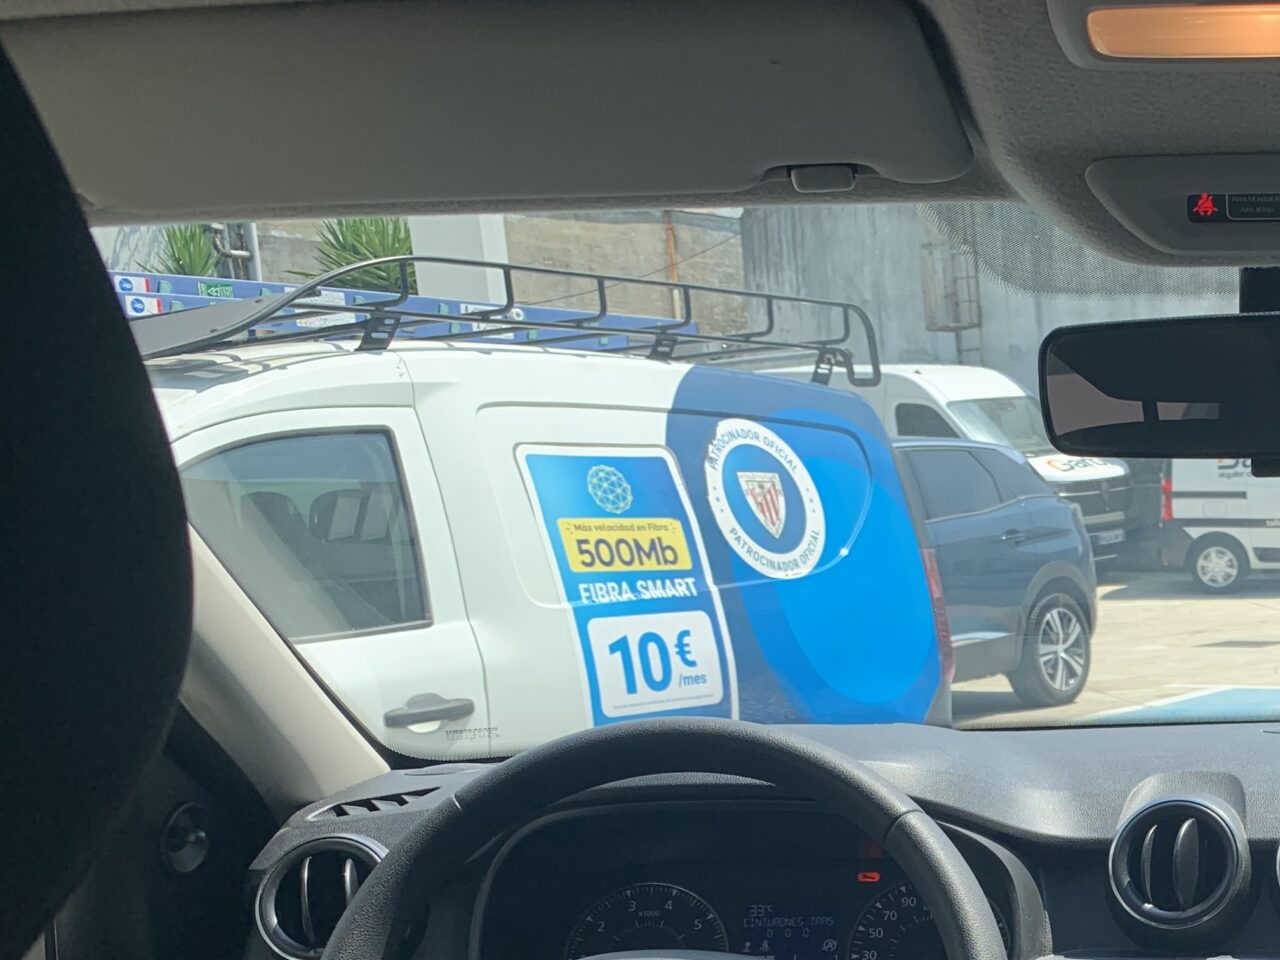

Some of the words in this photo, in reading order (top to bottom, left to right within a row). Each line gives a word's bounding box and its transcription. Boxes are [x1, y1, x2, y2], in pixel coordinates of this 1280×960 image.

[763, 436, 798, 473] OFICIAL
[576, 536, 678, 567] 500Mb
[729, 527, 801, 572] PATROCINADOR
[799, 529, 820, 564] OFICIAL
[578, 581, 637, 604] FIBRA
[636, 577, 698, 600] SMART
[628, 900, 637, 912] 3
[664, 900, 673, 911] 4
[901, 896, 916, 908] 90
[883, 910, 898, 921] 70
[597, 920, 606, 932] 2
[694, 920, 702, 930] 5
[868, 927, 884, 938] 50
[862, 950, 877, 960] 30
